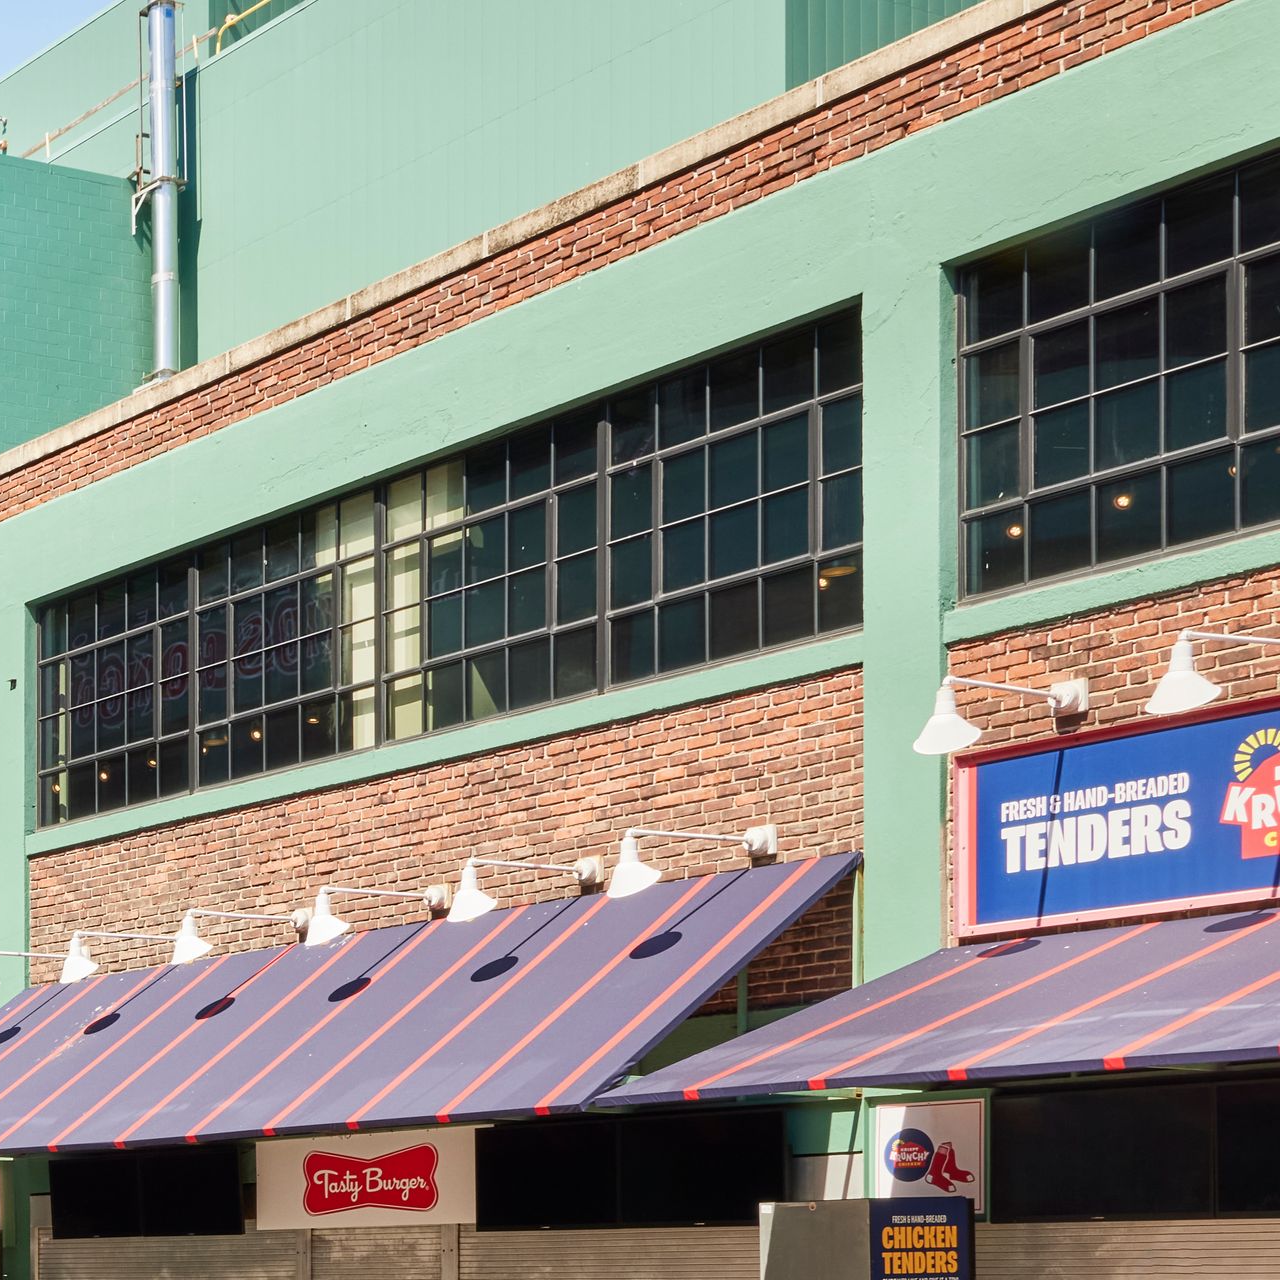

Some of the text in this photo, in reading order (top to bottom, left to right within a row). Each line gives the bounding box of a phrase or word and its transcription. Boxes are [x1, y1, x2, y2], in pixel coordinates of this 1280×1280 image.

[1001, 772, 1189, 822] FRESH & HAND-BREADED
[1001, 800, 1191, 873] TENDERS
[889, 1151, 930, 1162] KRUNCHY
[313, 1167, 427, 1202] Tasty Burger
[892, 1215, 906, 1223] FRESH
[911, 1215, 947, 1223] HAND-BREADED
[882, 1225, 958, 1249] CHICKEN
[881, 1251, 958, 1274] TENDERS
